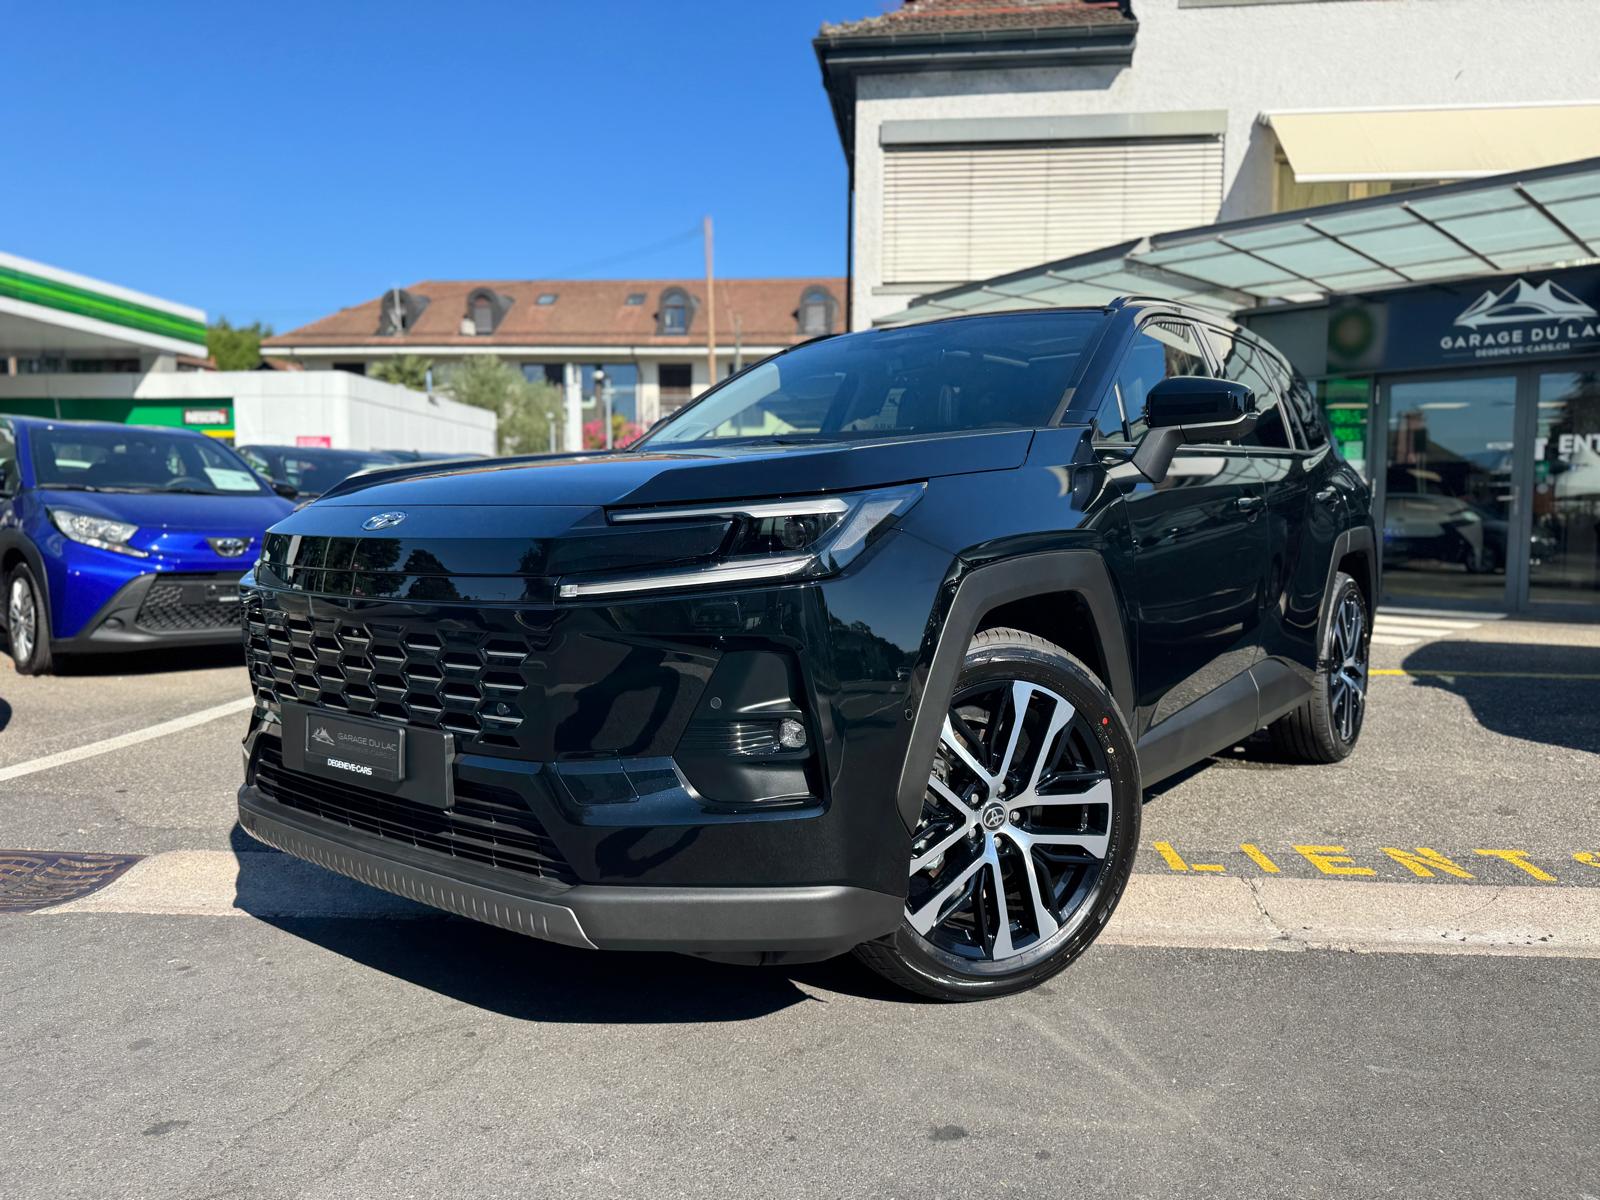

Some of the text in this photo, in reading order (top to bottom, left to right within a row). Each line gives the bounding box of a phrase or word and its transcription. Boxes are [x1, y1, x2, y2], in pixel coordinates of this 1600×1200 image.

[1440, 330, 1523, 349] GARAGE
[1531, 326, 1559, 341] DU
[337, 732, 368, 746] GARAGE
[368, 739, 380, 748] DU
[381, 742, 397, 752] LAC
